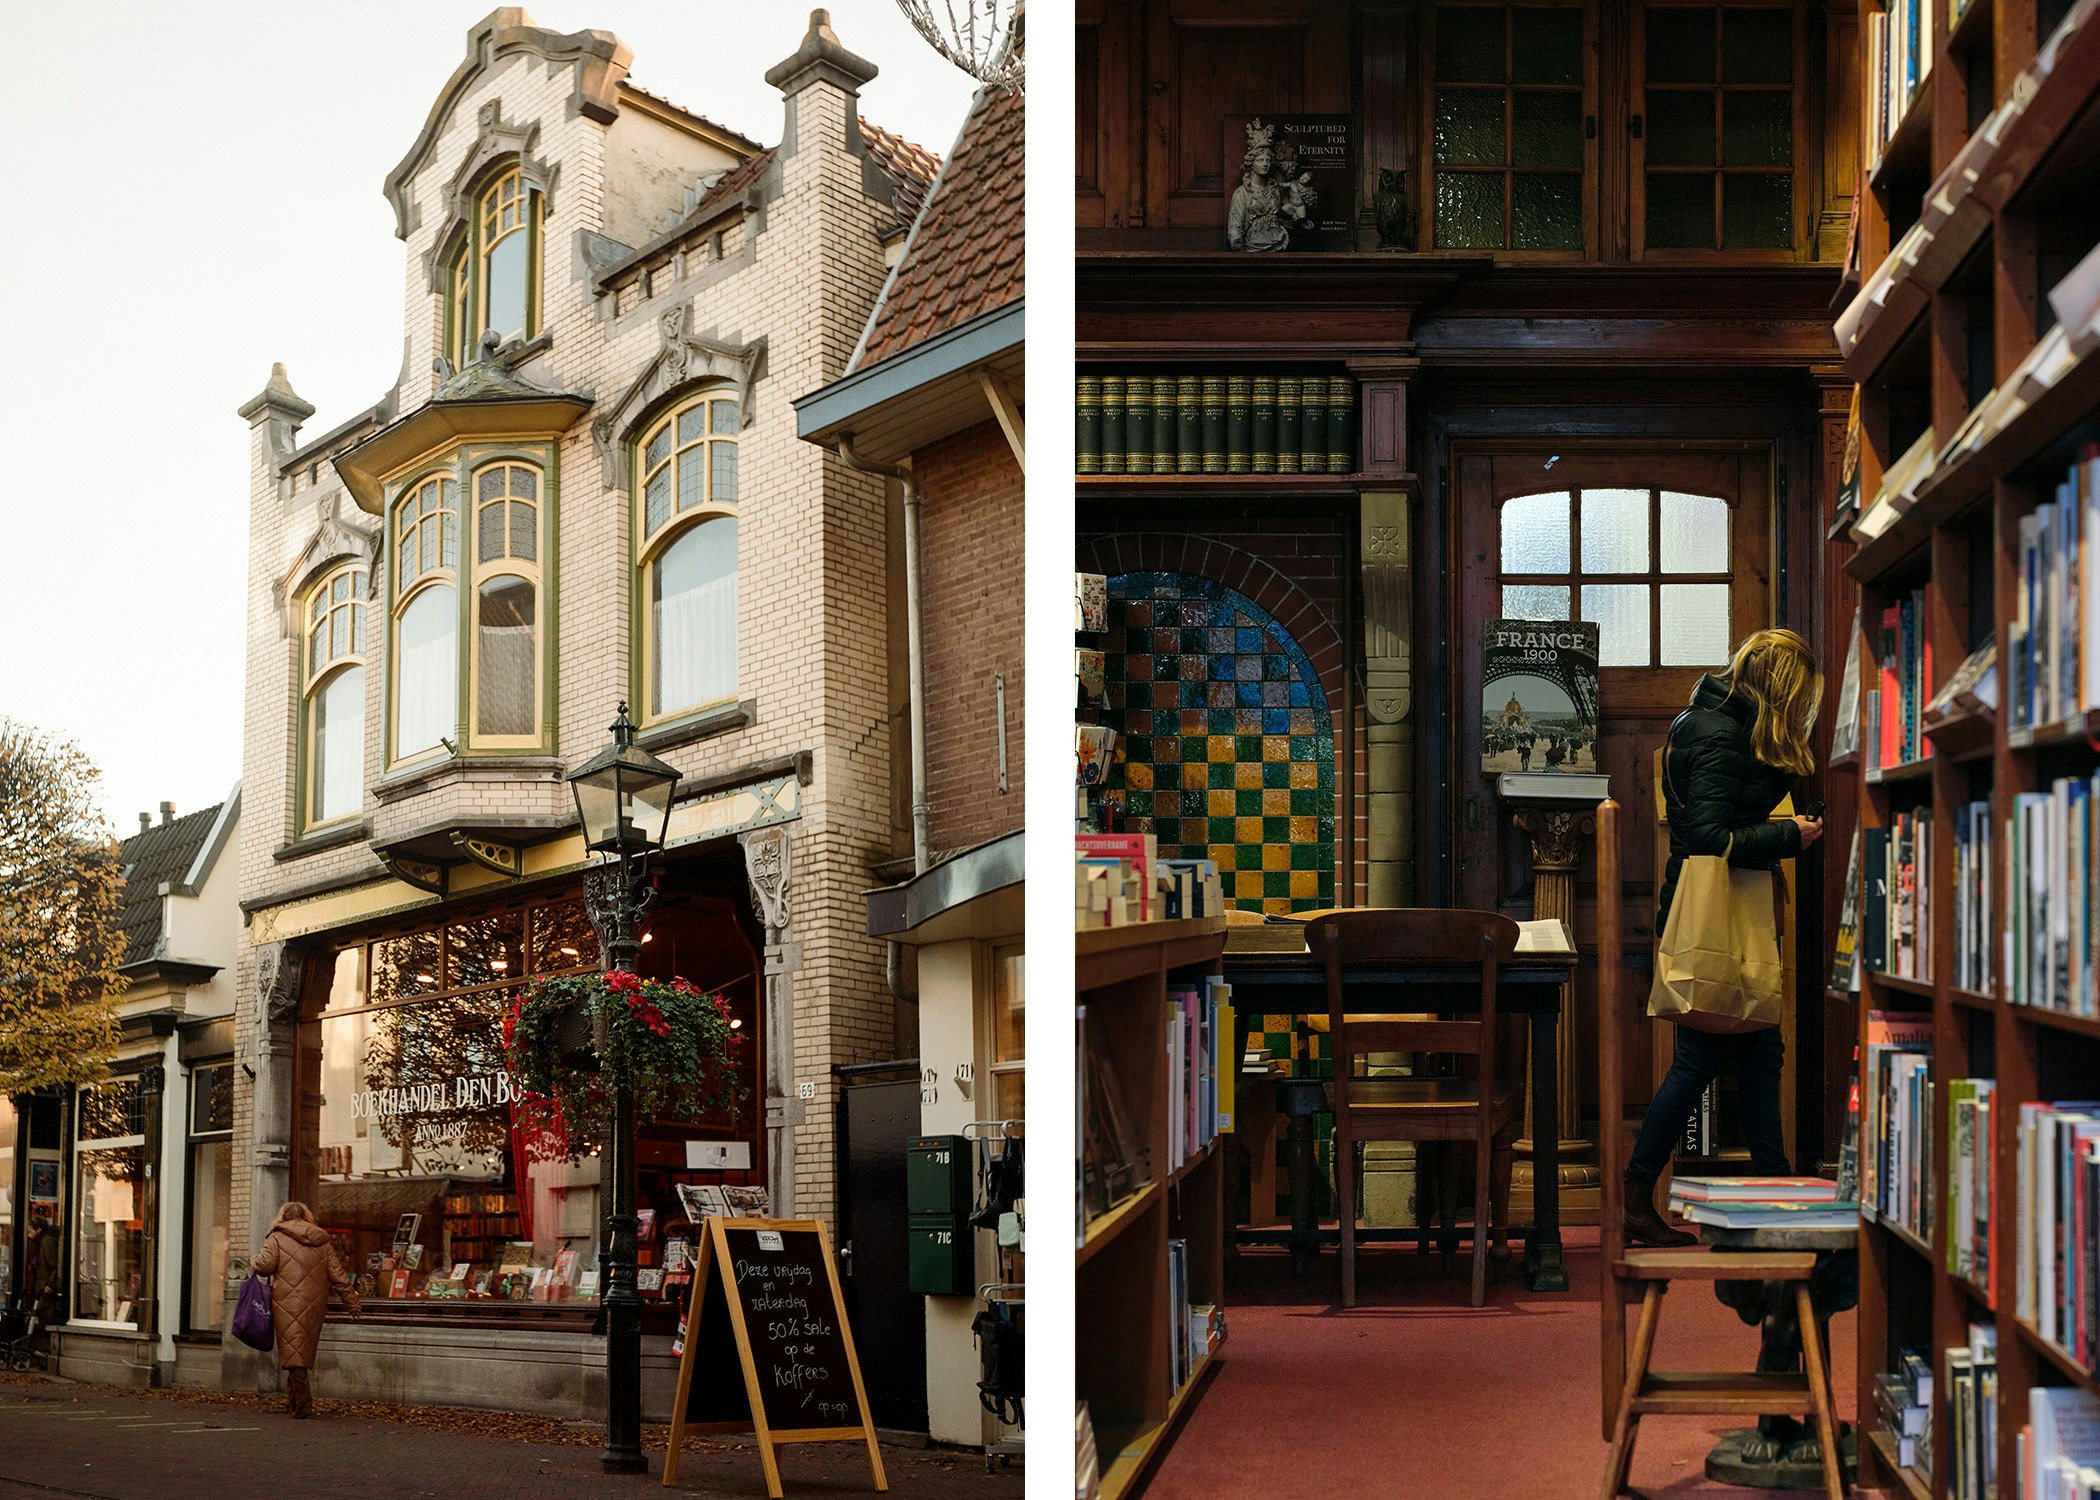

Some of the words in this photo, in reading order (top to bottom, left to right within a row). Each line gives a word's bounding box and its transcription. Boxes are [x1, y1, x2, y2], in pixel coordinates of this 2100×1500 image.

[1284, 123, 1346, 133] SCULPTURED
[1327, 136, 1346, 144] FOR
[1299, 145, 1346, 155] ETERNITY
[1495, 631, 1585, 650] FRANCE
[1523, 649, 1558, 661] 1900
[350, 1083, 450, 1118] BOEKHANDEL
[456, 1076, 492, 1109] DEN
[801, 1083, 813, 1097] 69
[415, 1124, 440, 1142] ANNO
[441, 1121, 468, 1140] 1887
[1687, 1115, 1698, 1151] ATLAS
[935, 1152, 950, 1164] 71B
[937, 1231, 952, 1244] 71C
[736, 1259, 769, 1285] Deze
[763, 1281, 776, 1291] en
[768, 1317, 800, 1340] 50%
[784, 1345, 799, 1364] op
[803, 1343, 815, 1355] de
